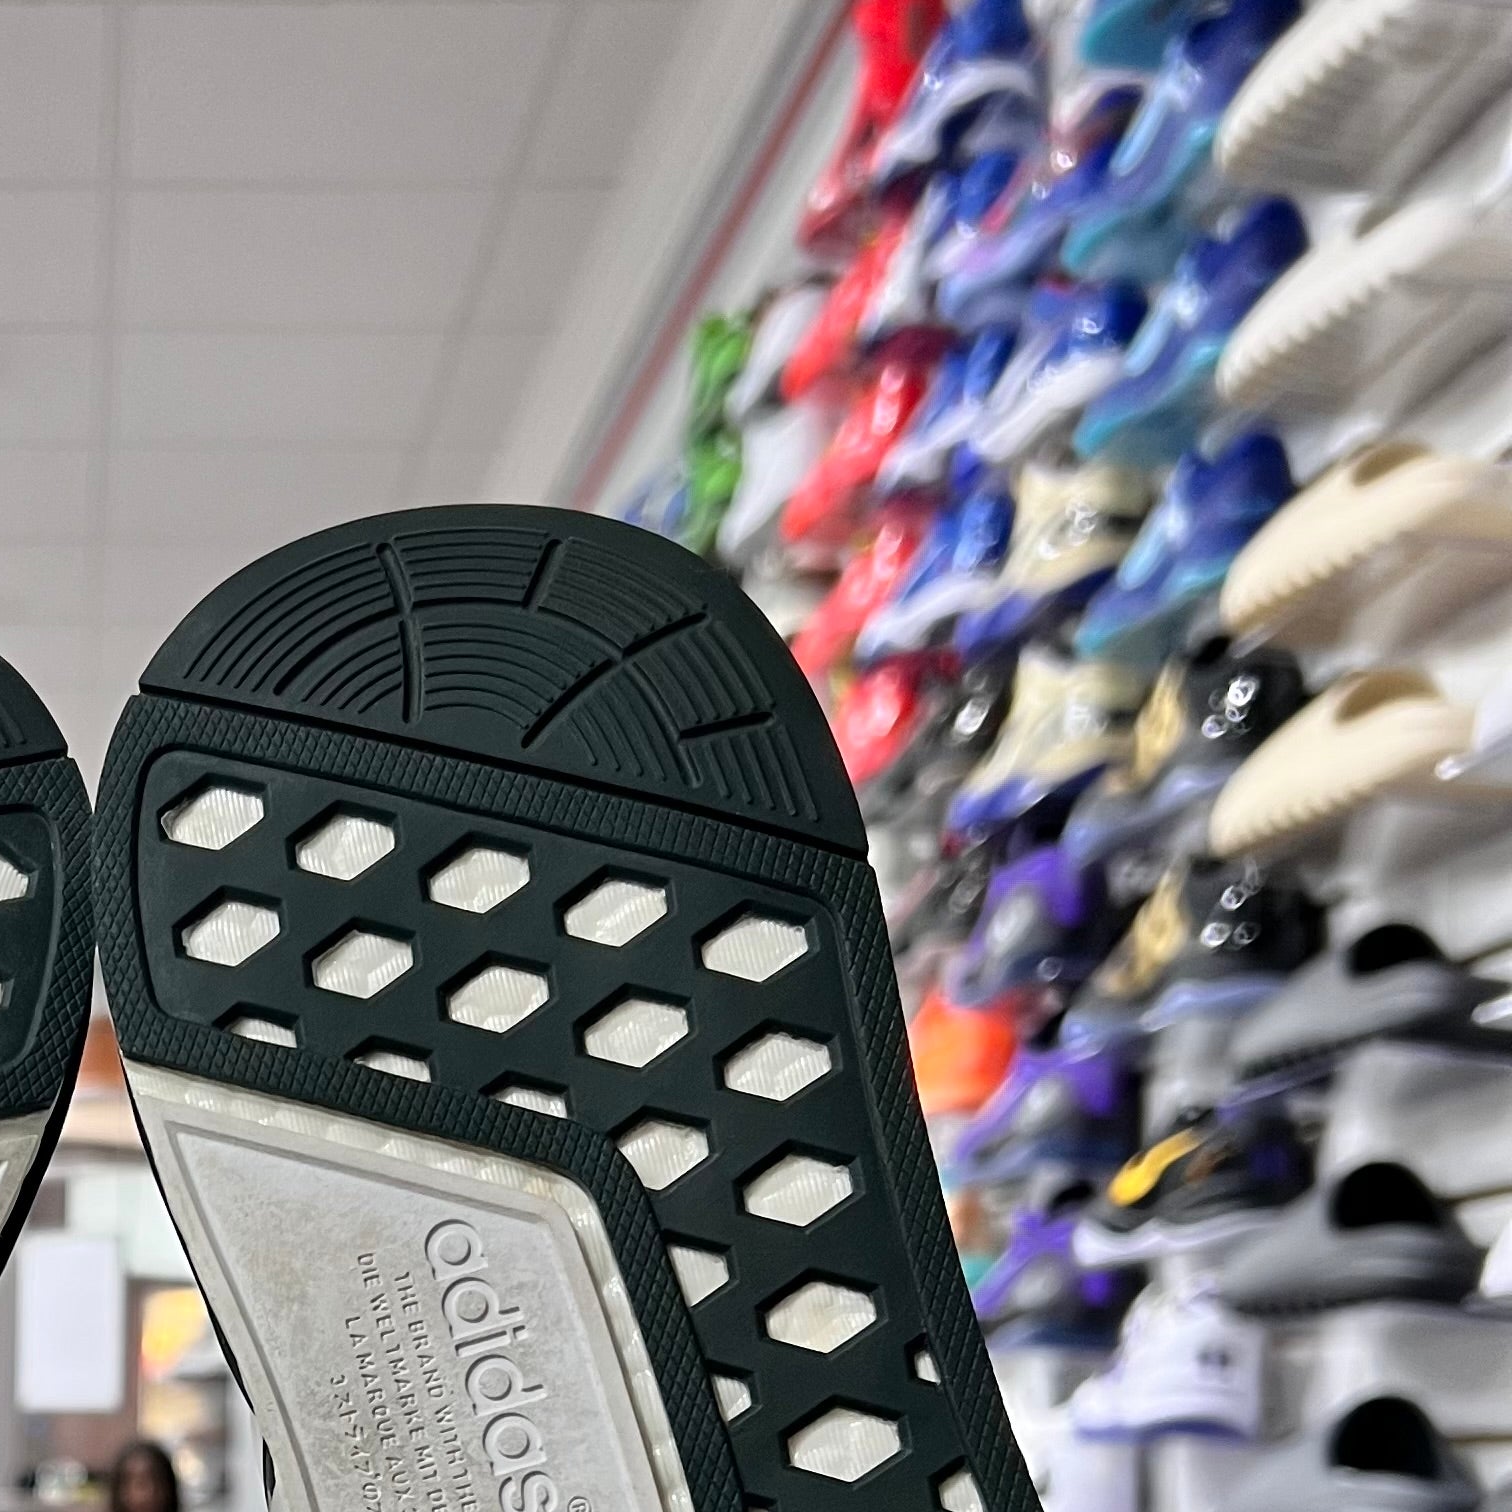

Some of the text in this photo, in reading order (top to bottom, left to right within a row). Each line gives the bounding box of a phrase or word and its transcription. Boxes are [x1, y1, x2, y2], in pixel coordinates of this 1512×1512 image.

[345, 1316, 368, 1348] LA
[357, 1252, 381, 1288] DIE
[369, 1292, 426, 1441] WELTMARKE
[414, 1445, 438, 1480] MIT
[394, 1271, 420, 1314] THE
[408, 1319, 443, 1398] BRAND
[434, 1403, 466, 1465] WITH
[356, 1352, 399, 1449] MARQUE
[385, 1456, 416, 1502] AUX
